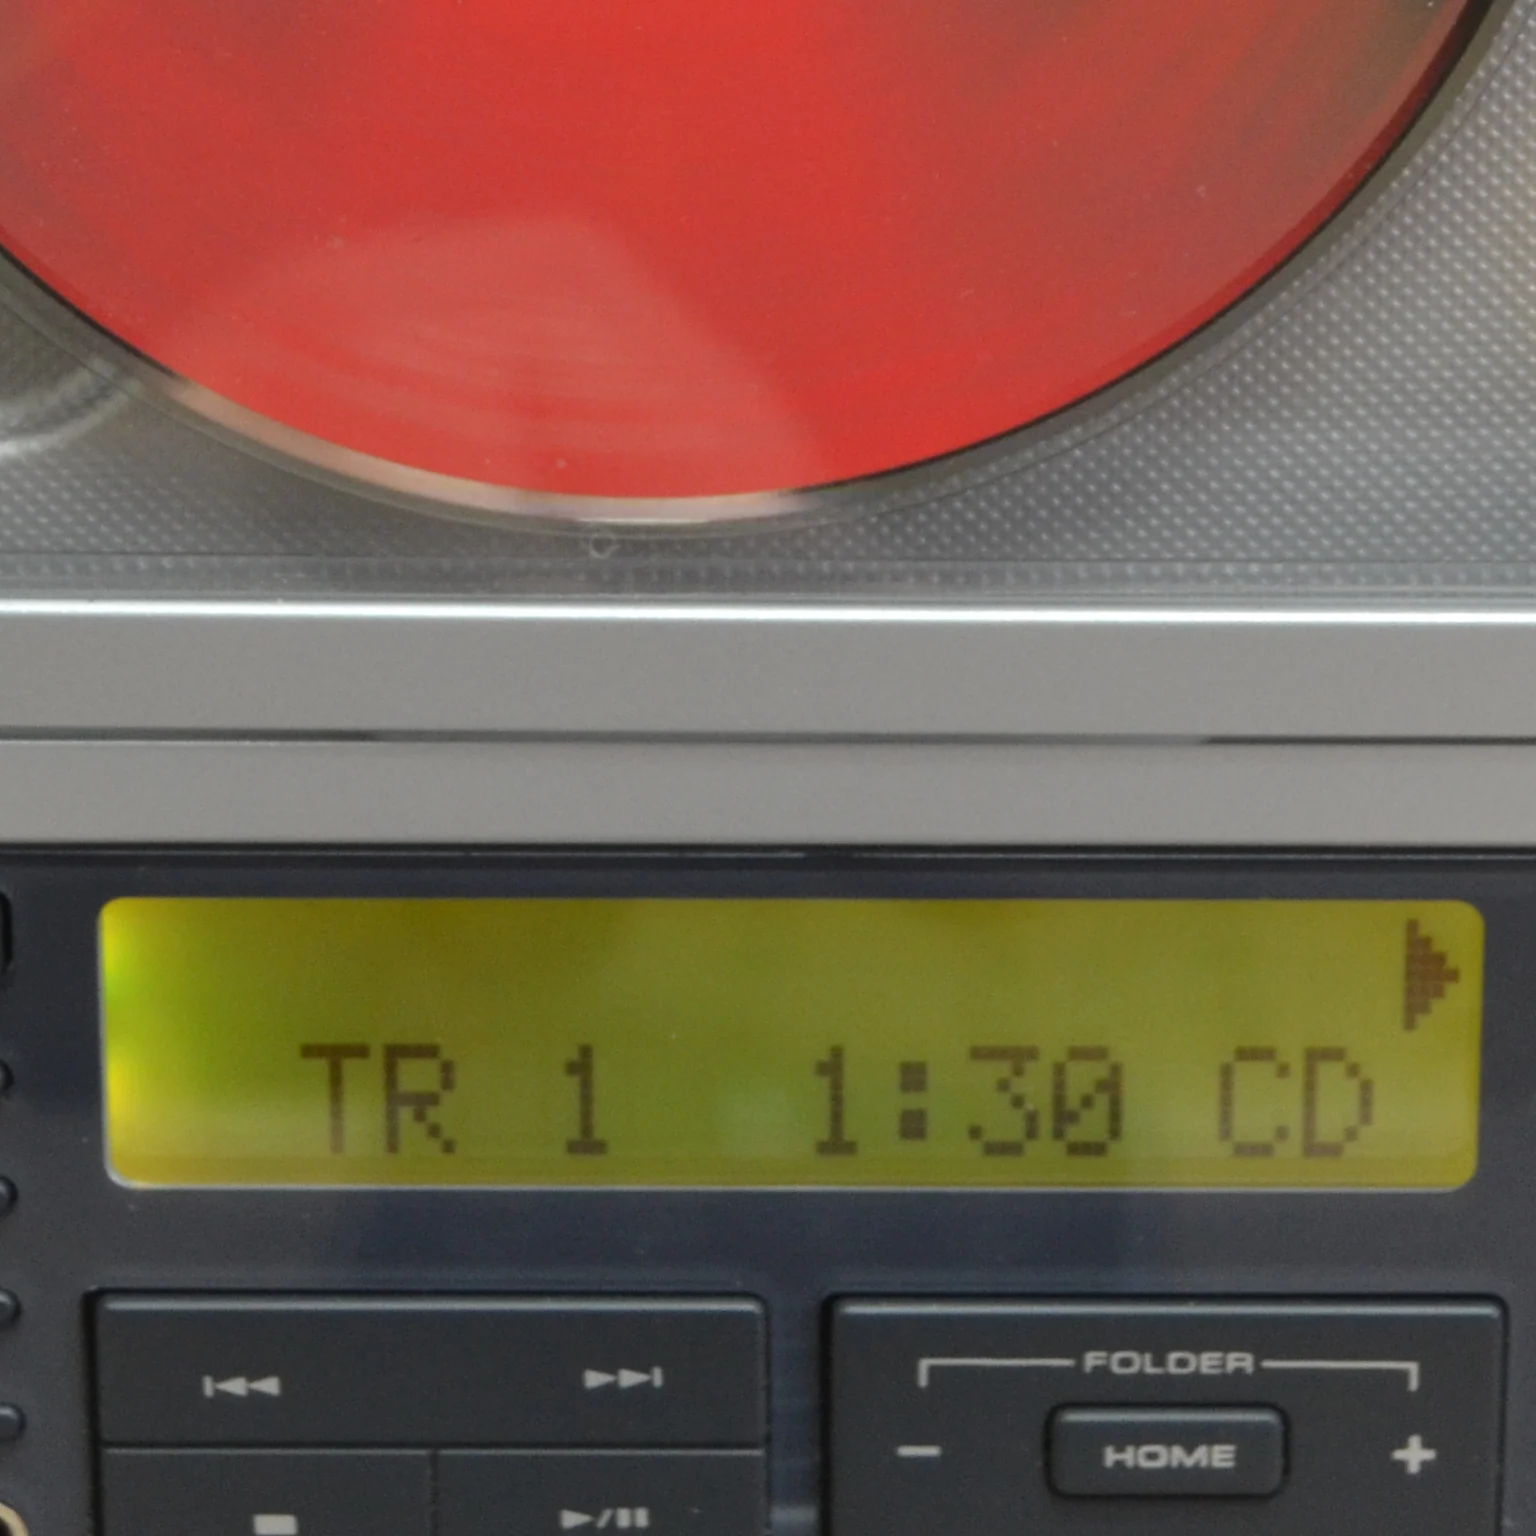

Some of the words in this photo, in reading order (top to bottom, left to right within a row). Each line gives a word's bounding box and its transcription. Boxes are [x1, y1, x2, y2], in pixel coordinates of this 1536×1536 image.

[300, 1042, 455, 1156] TR
[564, 1043, 608, 1156] 1
[814, 1044, 1123, 1157] 1:30
[1219, 1046, 1373, 1158] CD
[1083, 1349, 1255, 1375] FOLDER
[1103, 1443, 1237, 1469] HOME
